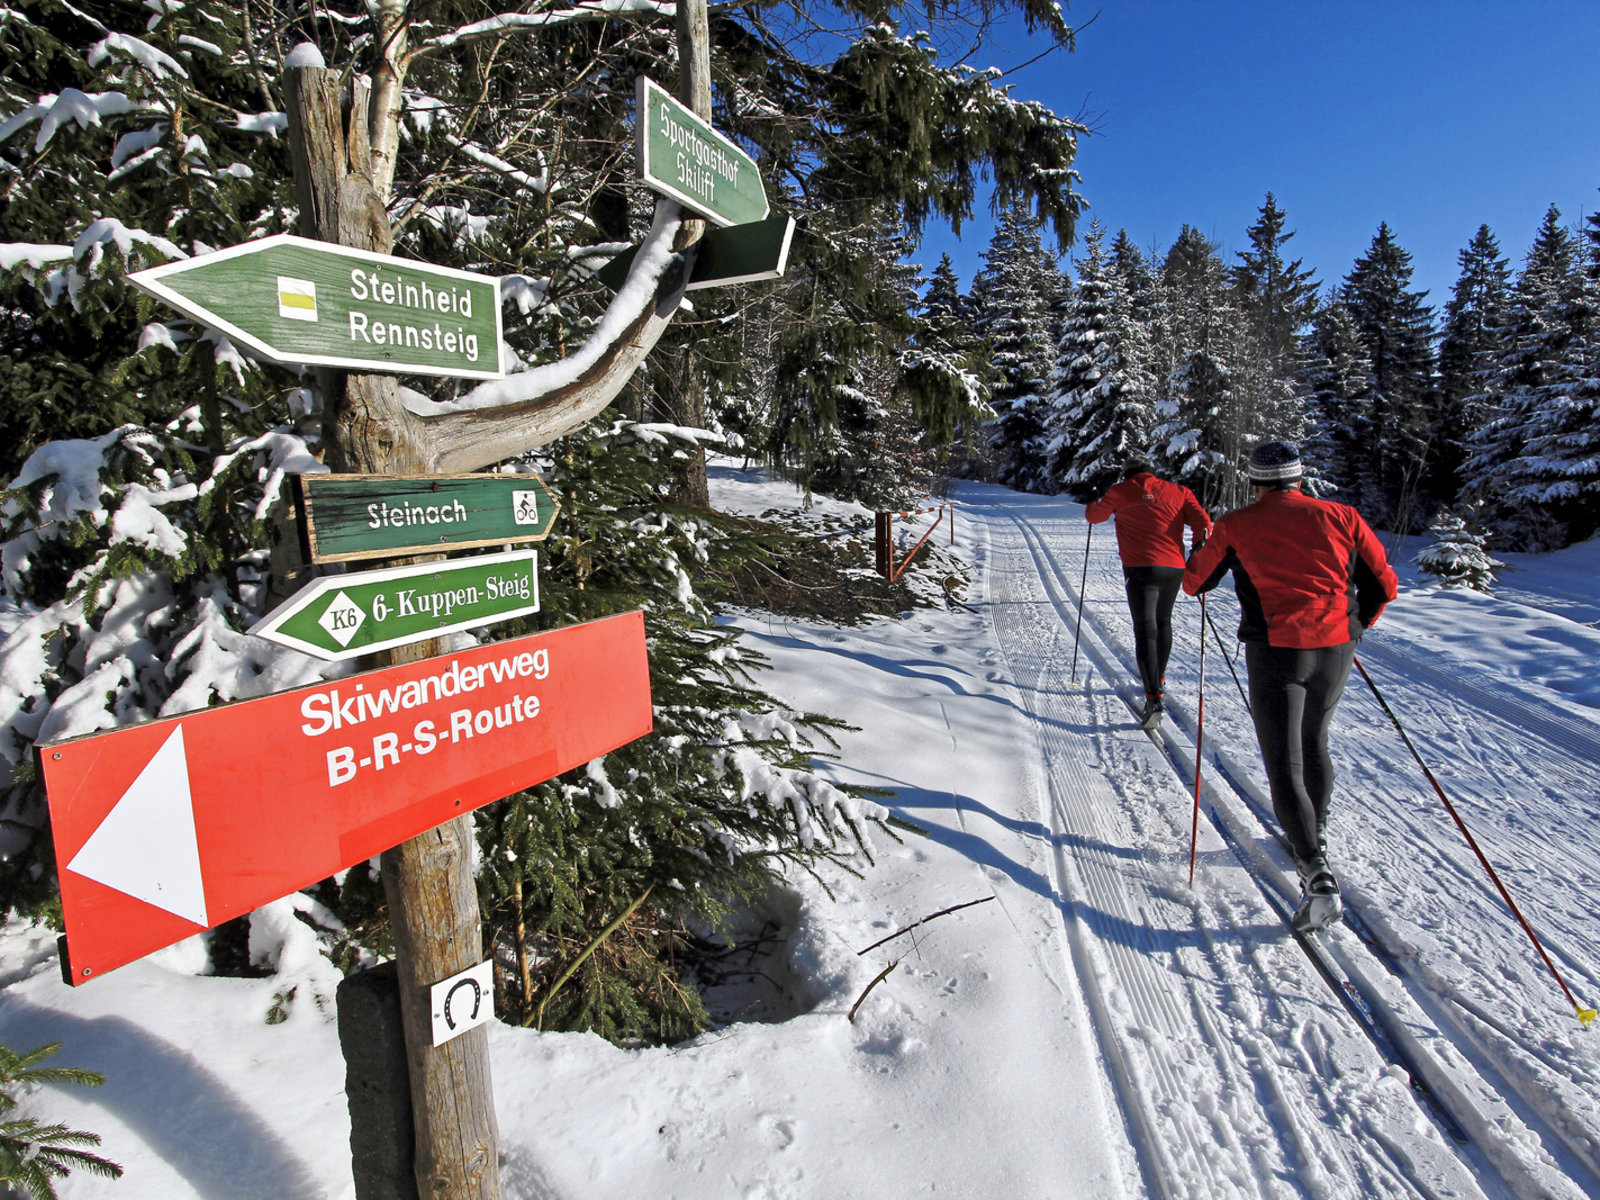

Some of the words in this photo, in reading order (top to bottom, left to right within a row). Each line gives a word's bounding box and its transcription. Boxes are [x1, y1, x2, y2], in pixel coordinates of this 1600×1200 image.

[660, 102, 739, 188] Sportgasthof
[677, 151, 715, 201] Skilift
[350, 268, 472, 318] Steinheid
[349, 311, 478, 362] Rennsteig
[367, 499, 468, 529] Steinach
[331, 607, 358, 631] K6
[372, 572, 530, 622] 6-Kuppen-Steig
[300, 648, 550, 737] Skiwanderweg
[326, 695, 541, 788] B-R-S-Route
